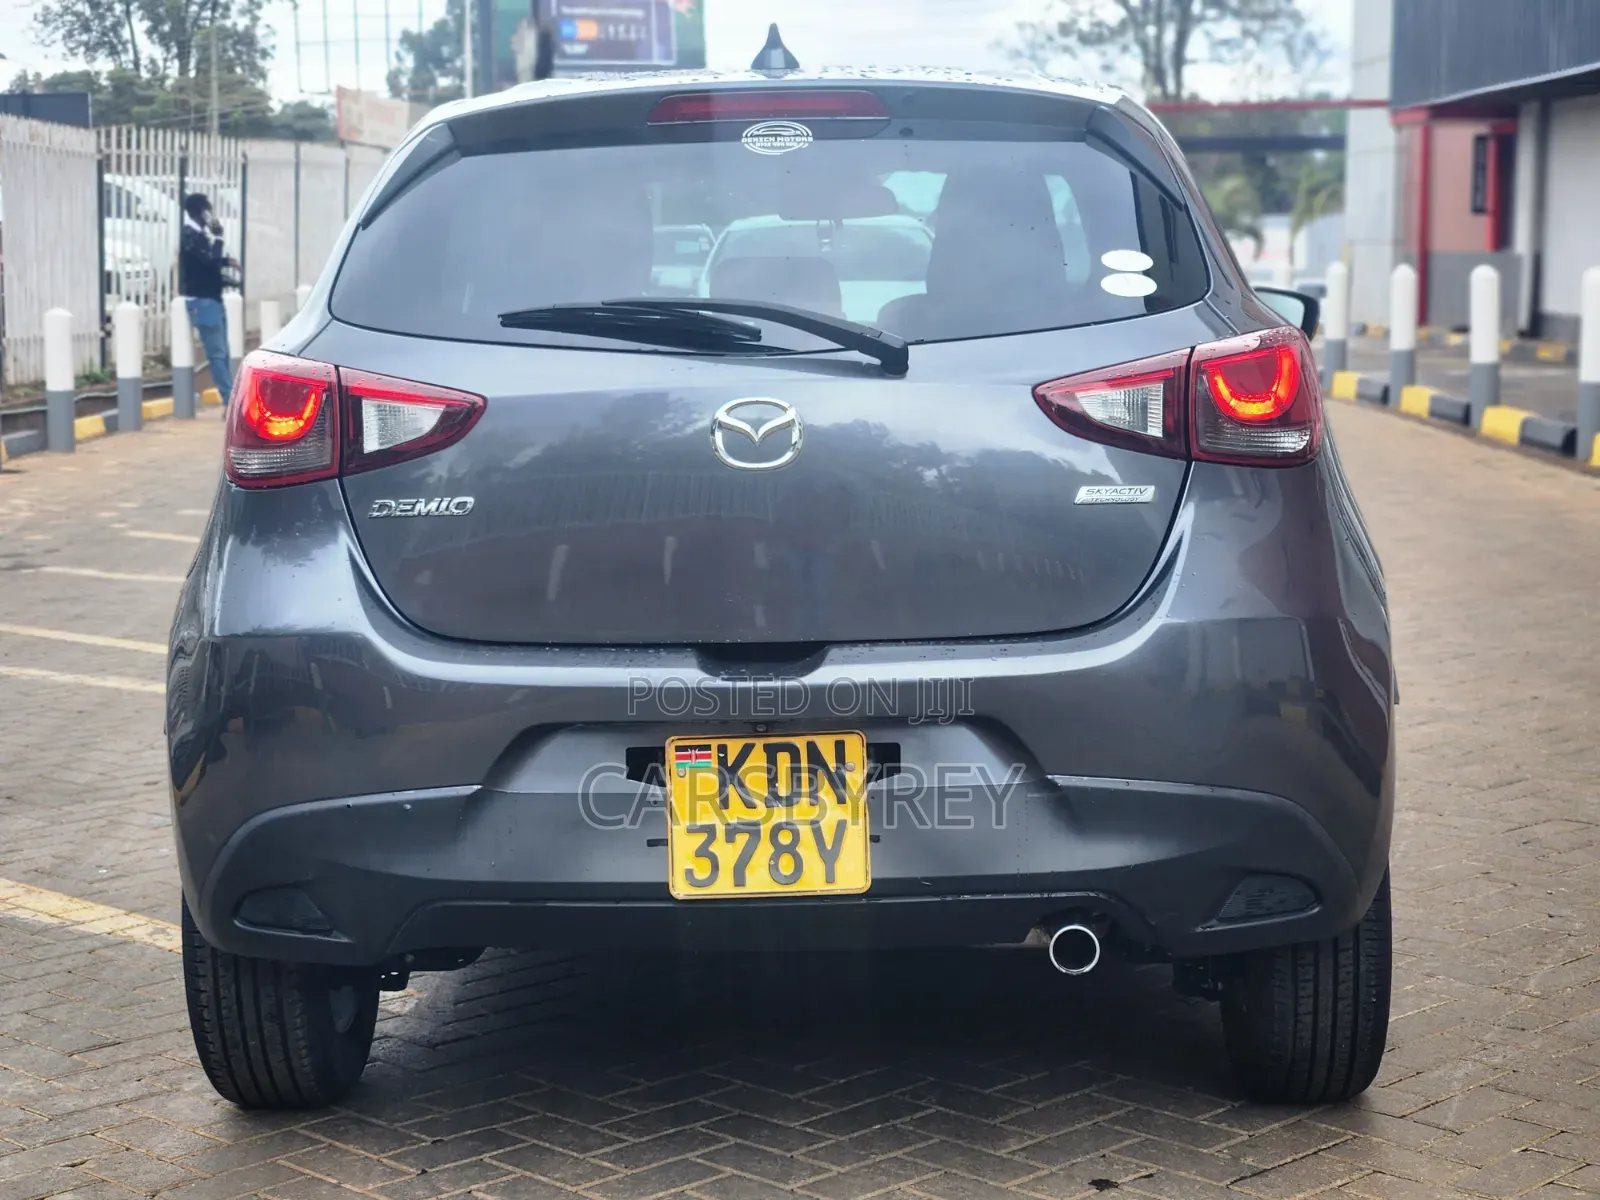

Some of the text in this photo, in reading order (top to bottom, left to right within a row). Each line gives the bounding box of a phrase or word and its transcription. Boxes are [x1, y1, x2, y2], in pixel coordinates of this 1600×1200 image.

[368, 496, 475, 518] DEMIO
[1085, 487, 1148, 495] SKYACTIV
[717, 739, 847, 809] KDN
[684, 819, 848, 888] 378Y
